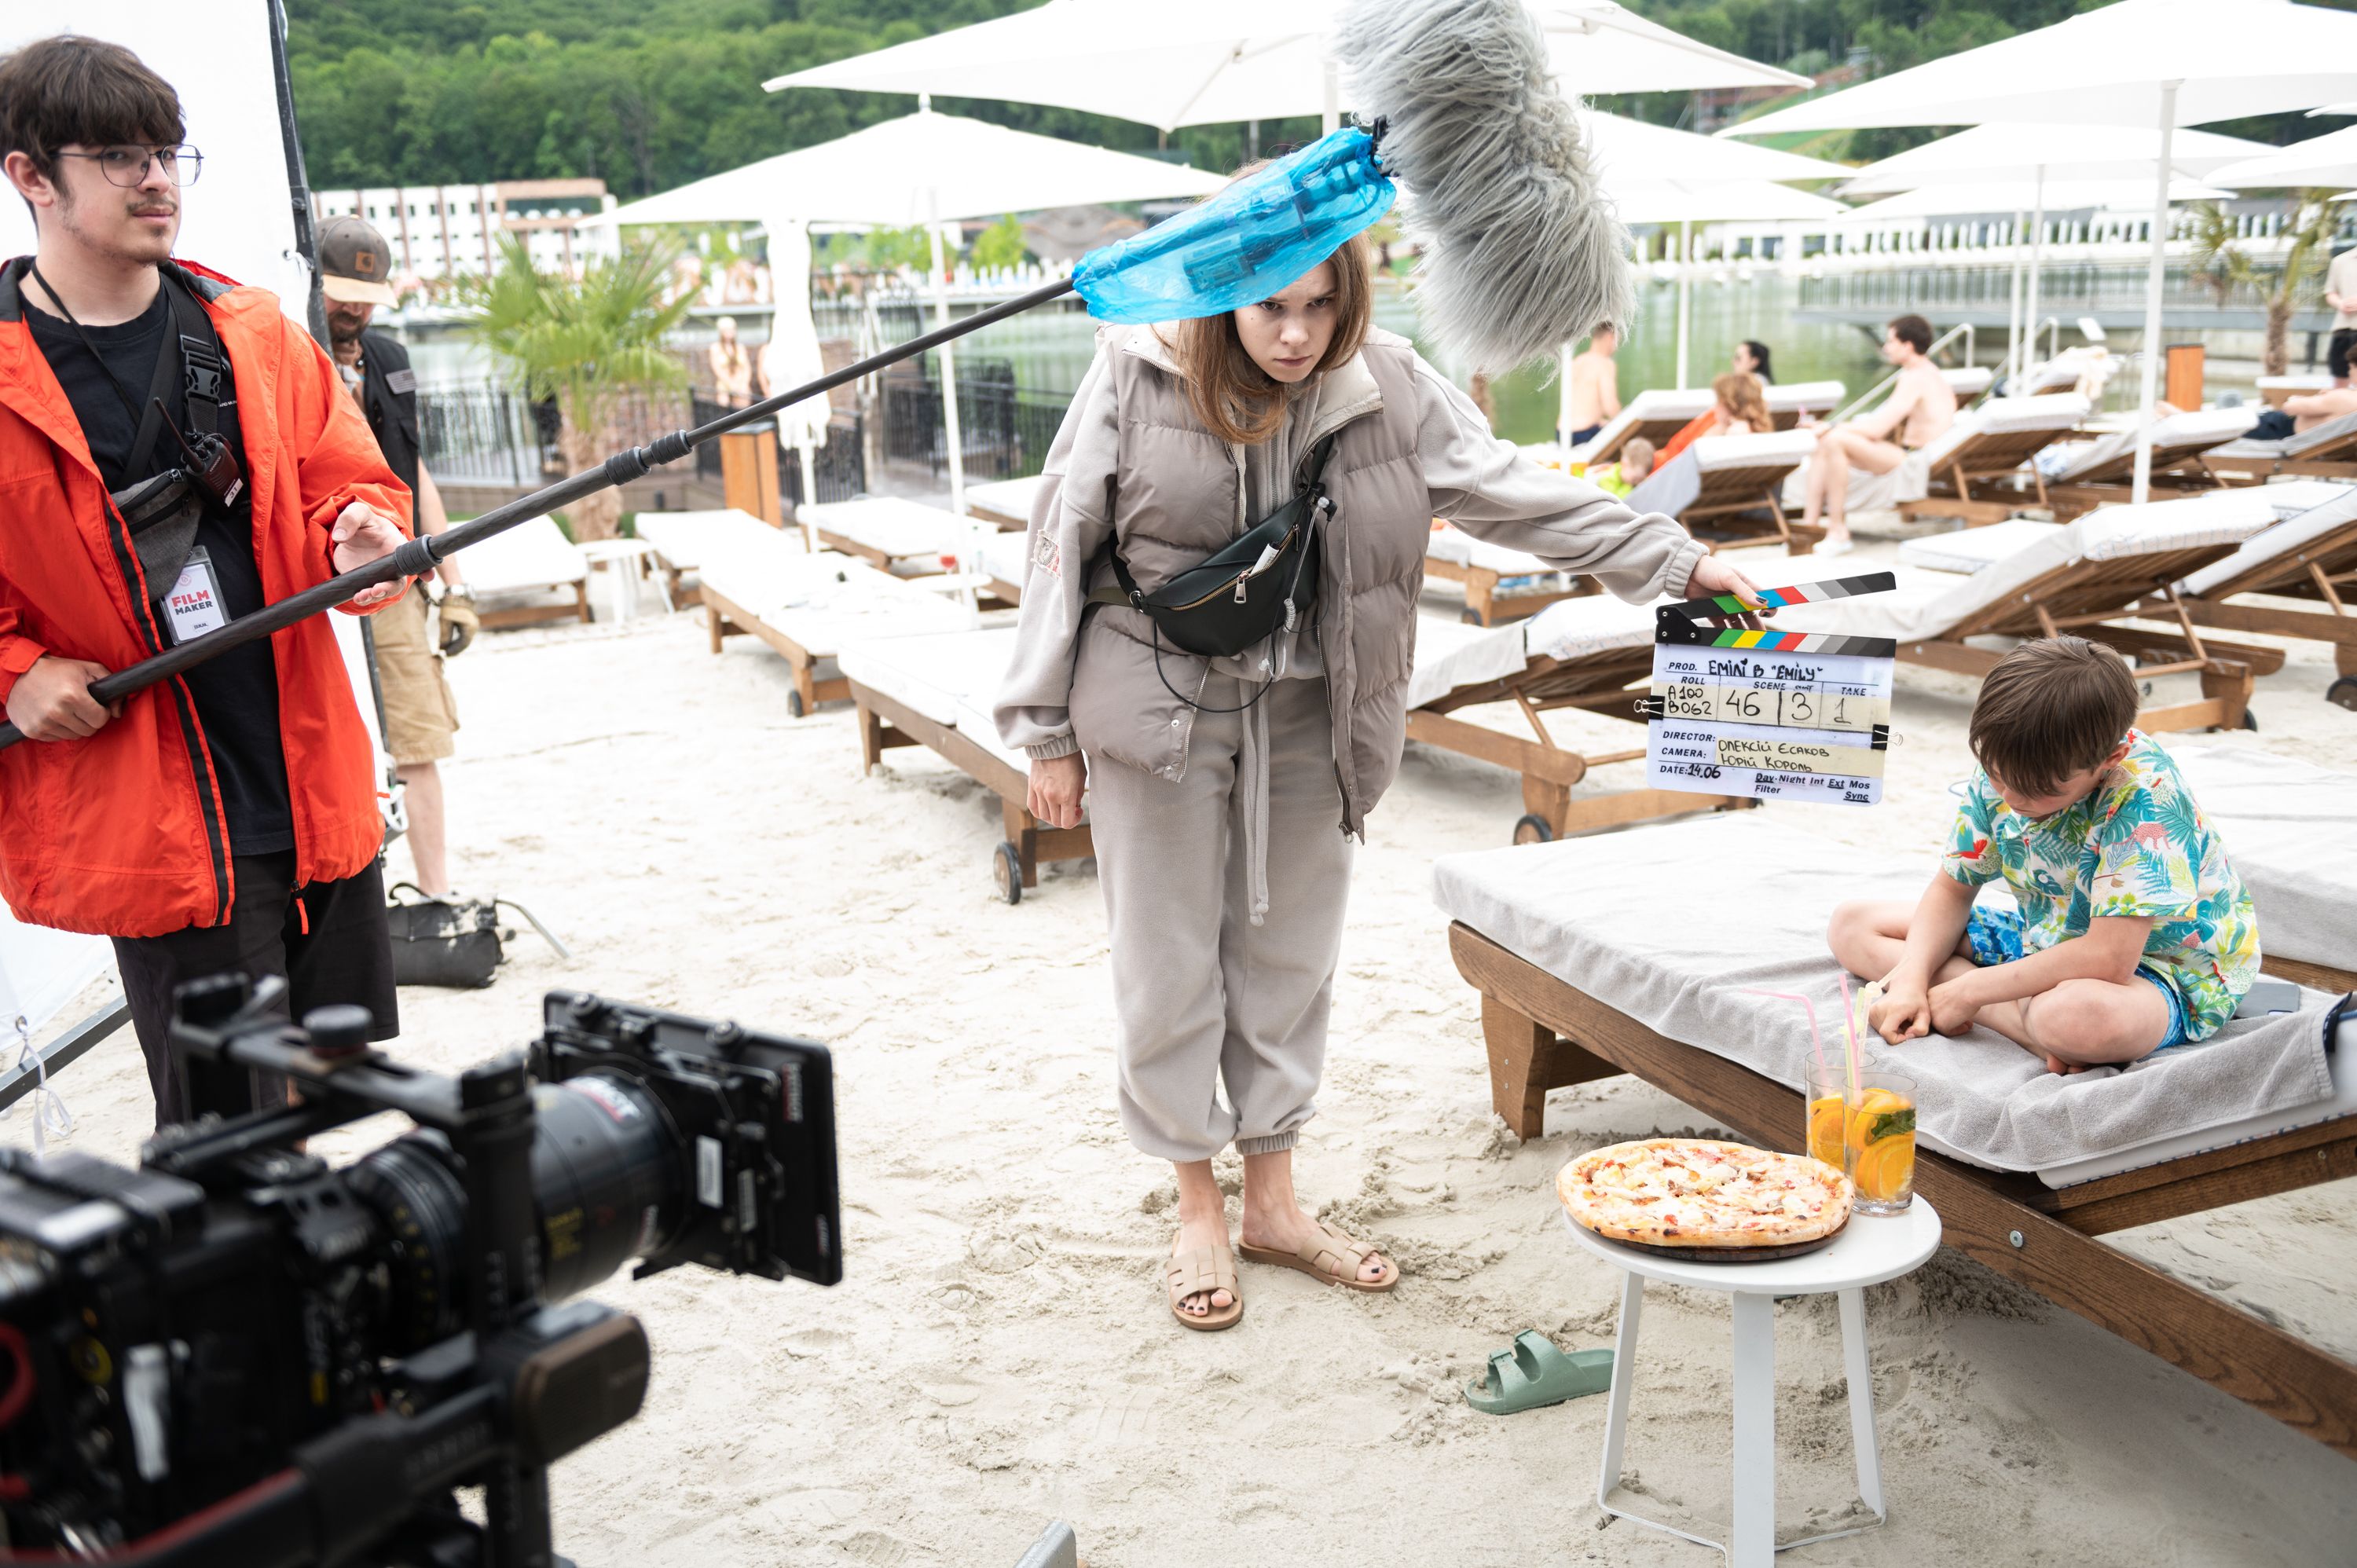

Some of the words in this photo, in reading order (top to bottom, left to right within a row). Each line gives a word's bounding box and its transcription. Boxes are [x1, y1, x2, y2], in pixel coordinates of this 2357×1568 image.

[171, 590, 210, 607] FILM
[174, 601, 214, 615] MAKER
[1668, 662, 1697, 671] PROD.
[1681, 676, 1705, 685] ROLL
[1754, 681, 1786, 691] SCENE
[1842, 687, 1867, 696] TAKE
[1668, 701, 1712, 715] B062
[1726, 690, 1760, 716] 46
[1792, 692, 1812, 720] 3
[1834, 698, 1852, 724] 1
[1662, 731, 1716, 742] DIRECTOR:
[1662, 747, 1706, 759] CAMERA:
[1660, 765, 1688, 775] DATE:
[1688, 764, 1721, 779] 14.06
[1779, 775, 1805, 784] Night
[1810, 777, 1824, 786] Int
[1828, 779, 1845, 788] Ext
[1849, 780, 1870, 789] Mos
[1754, 784, 1781, 794] Filter
[1845, 791, 1869, 801] Sync
